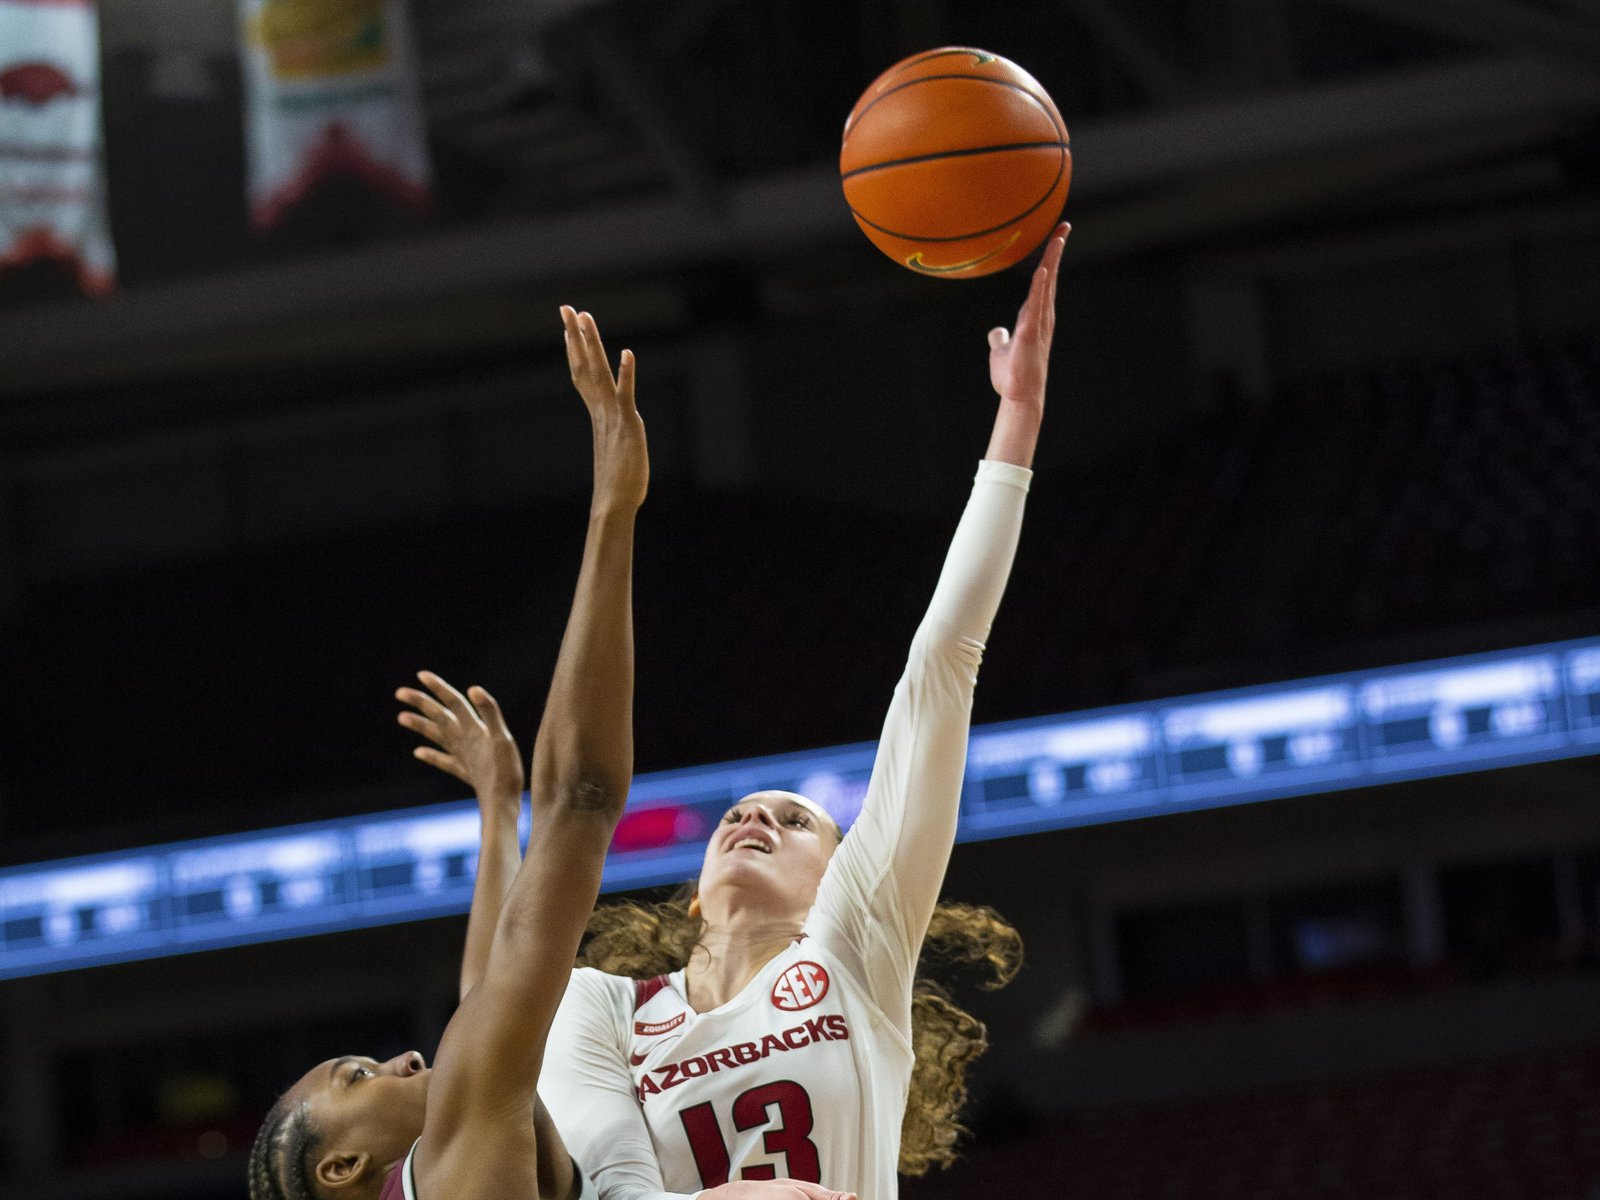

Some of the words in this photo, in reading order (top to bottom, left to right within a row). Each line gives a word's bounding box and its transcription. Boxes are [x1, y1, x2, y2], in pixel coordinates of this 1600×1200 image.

[773, 962, 827, 1009] SEC
[642, 1014, 684, 1033] EQUALITY
[634, 1015, 849, 1102] AZORBACKS
[679, 1079, 821, 1190] 13
